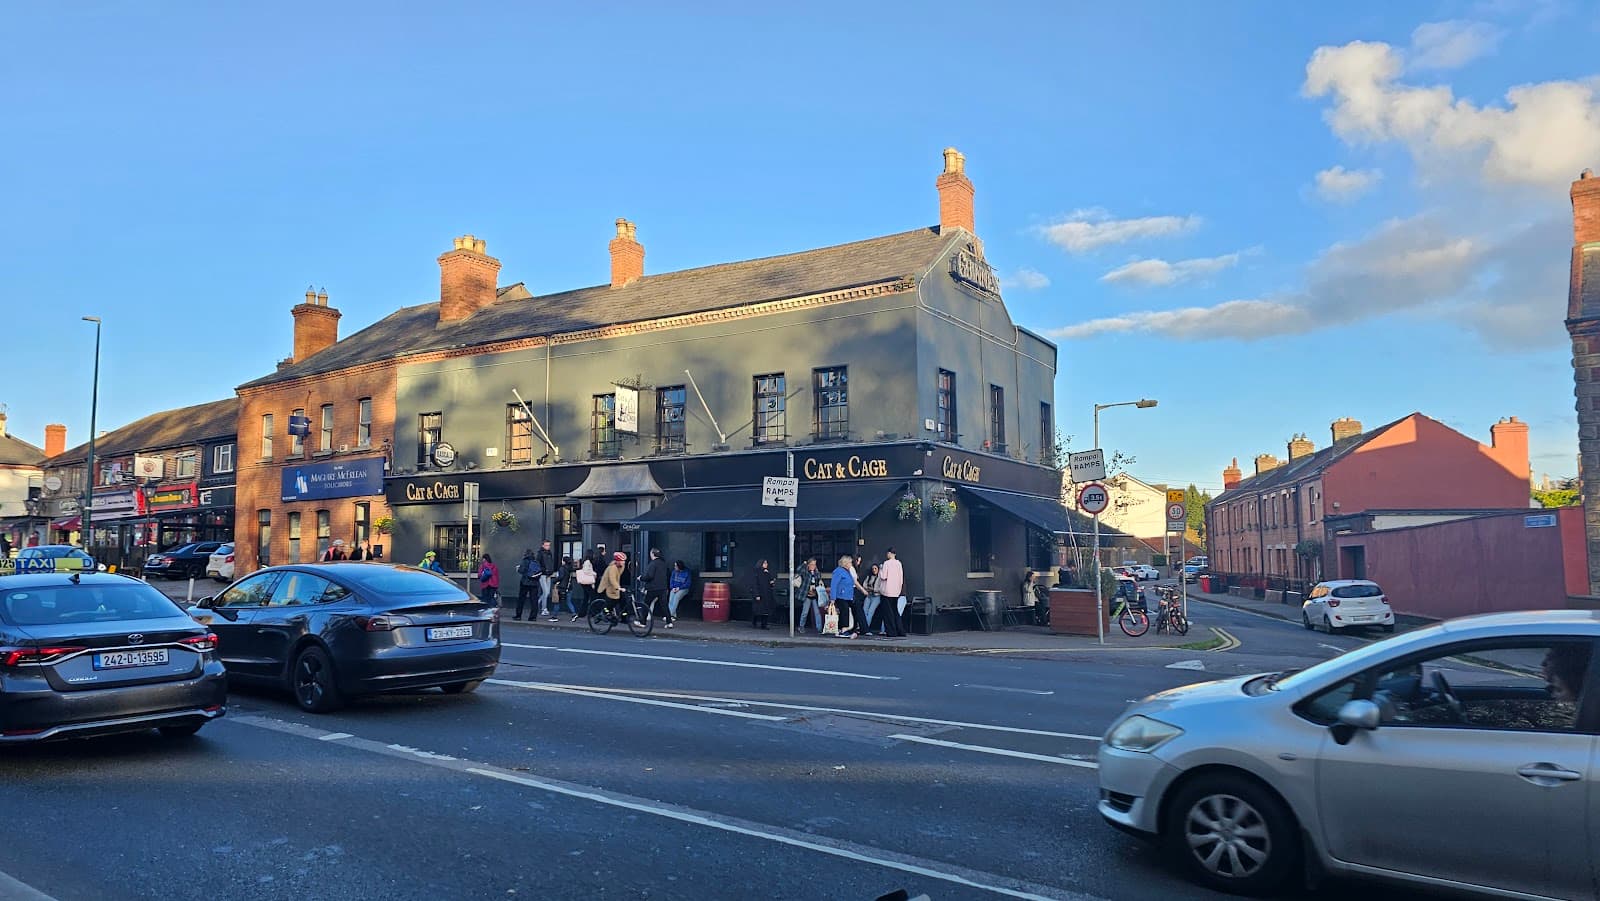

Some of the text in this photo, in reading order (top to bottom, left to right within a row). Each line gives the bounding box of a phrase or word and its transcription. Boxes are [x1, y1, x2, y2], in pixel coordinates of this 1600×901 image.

[804, 455, 887, 479] CAT & CAGE
[943, 455, 981, 482] CAT & CAGE
[1074, 461, 1101, 470] RAMPS
[406, 481, 459, 500] CAT & CAGE
[766, 487, 794, 496] RAMPS
[17, 558, 54, 569] TAXI
[104, 652, 165, 666] 242-D-13595
